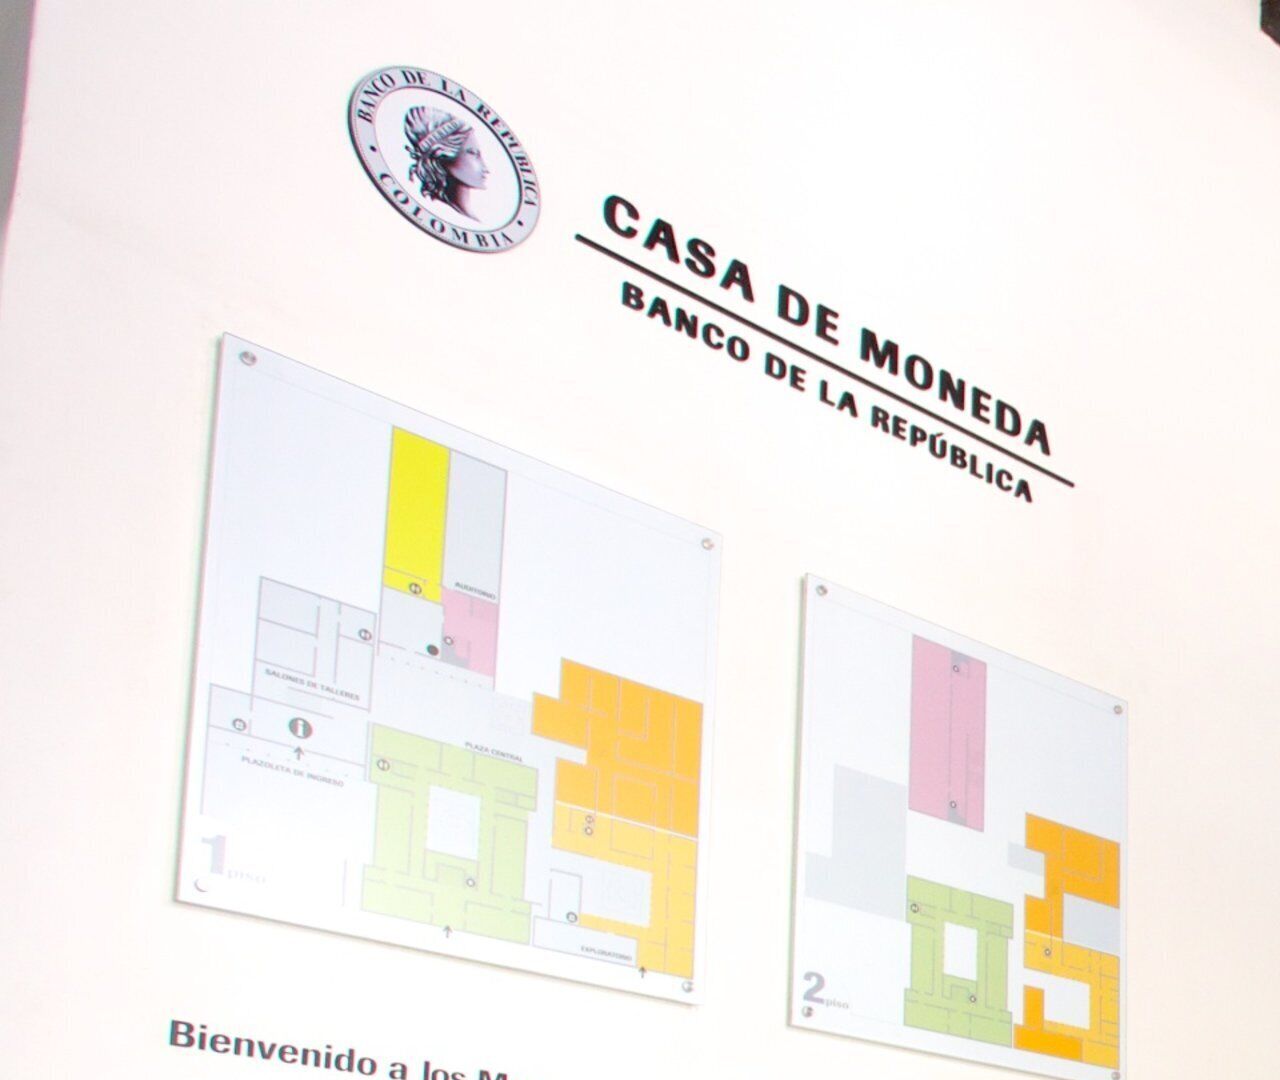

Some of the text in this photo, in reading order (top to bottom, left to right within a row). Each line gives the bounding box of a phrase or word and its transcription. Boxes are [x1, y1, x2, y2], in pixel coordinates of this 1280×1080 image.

[357, 73, 396, 124] BANCO
[401, 69, 431, 87] DE
[440, 78, 467, 102] LA
[379, 172, 514, 248] COLOMBIA
[603, 194, 1051, 457] CASA DE MONEDA
[621, 280, 1033, 504] BANCO DE LA REPÚBLICA
[265, 668, 306, 686] SALONES
[319, 684, 360, 702] TALLERES
[241, 754, 292, 775] PLAZOLETA
[306, 772, 345, 788] INGRESO
[464, 740, 490, 754] PLAZA
[803, 970, 825, 1005] 2
[168, 1018, 378, 1077] Bienvenido
